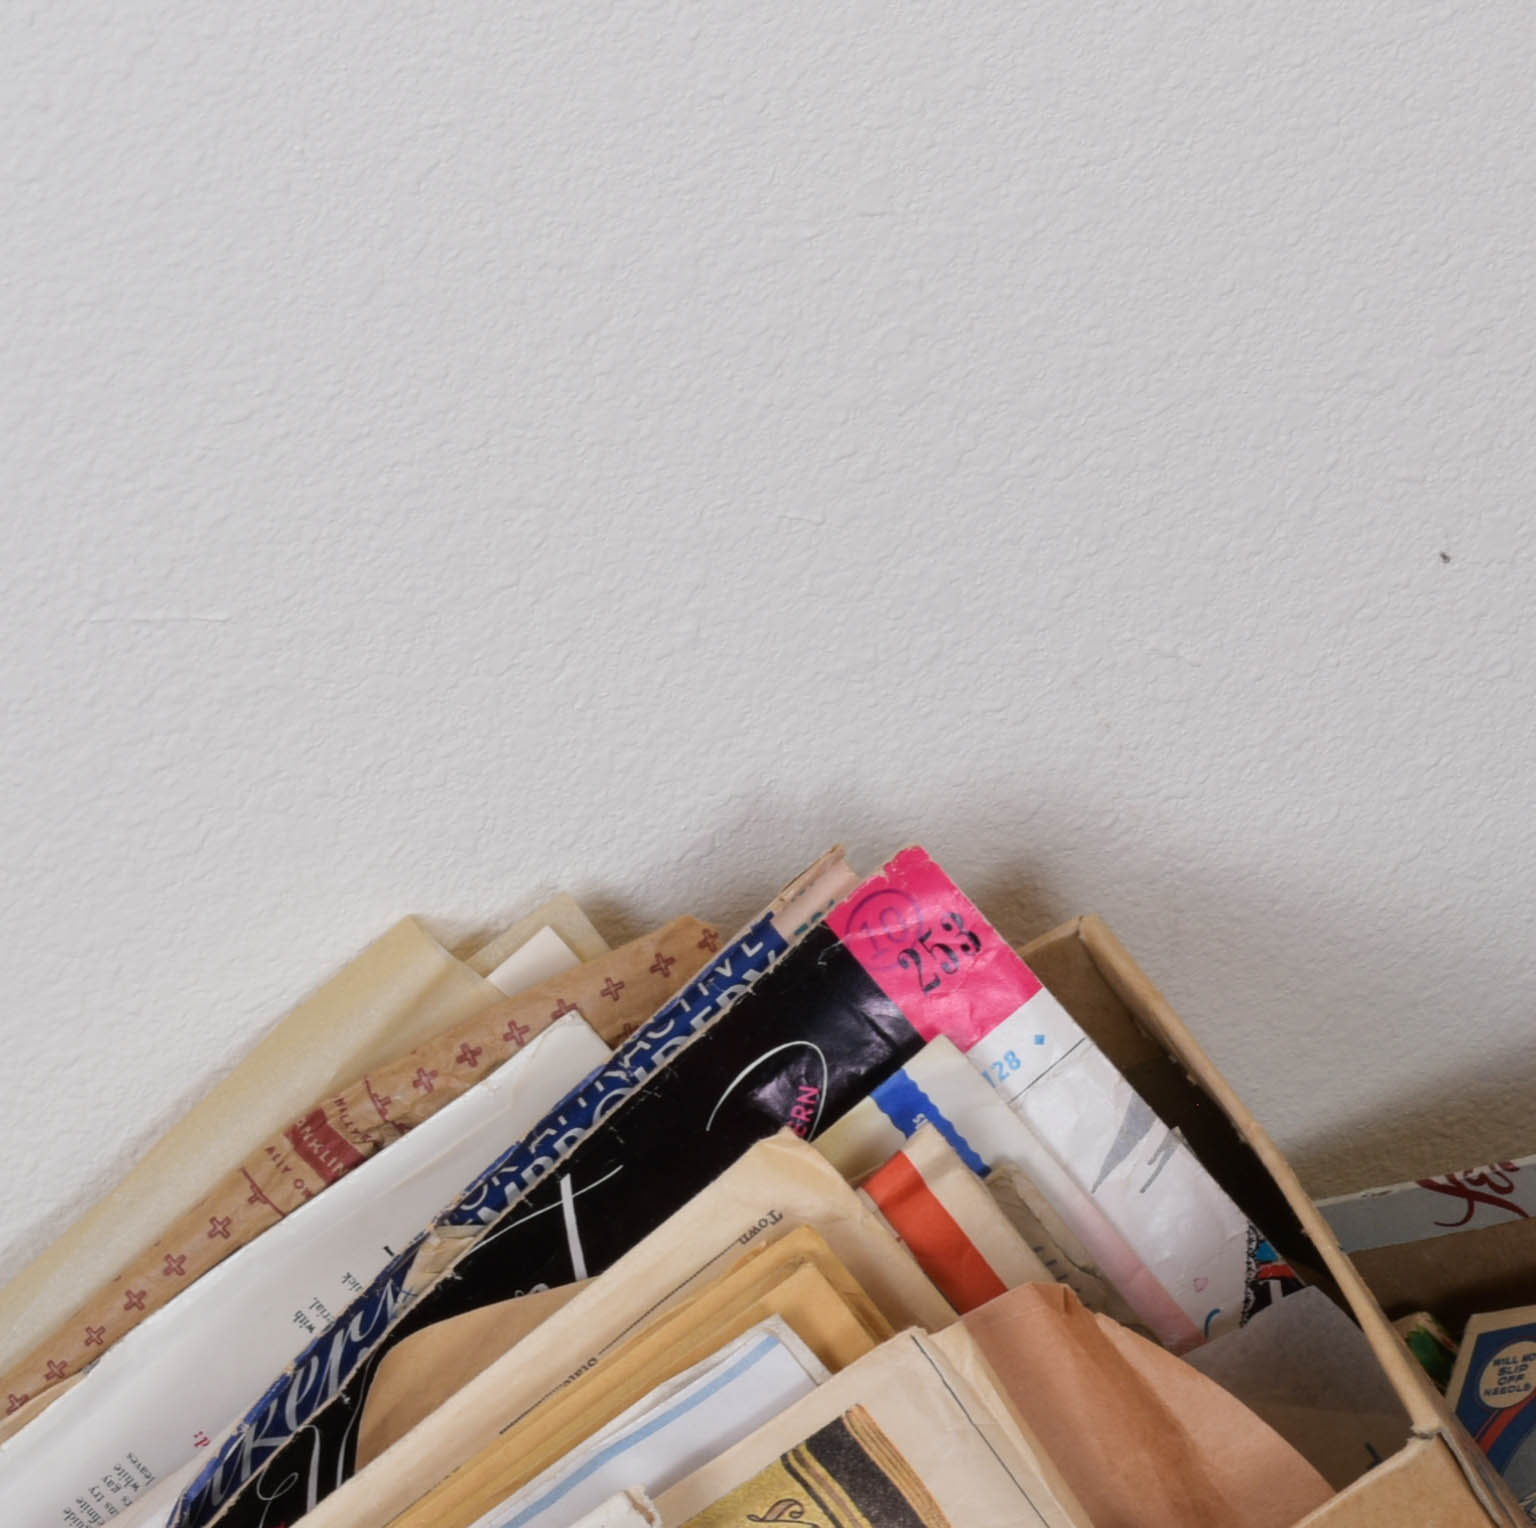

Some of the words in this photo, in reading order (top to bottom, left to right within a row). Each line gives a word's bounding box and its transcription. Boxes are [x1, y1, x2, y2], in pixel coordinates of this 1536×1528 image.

[898, 911, 983, 995] 253
[737, 1208, 784, 1245] Town
[292, 1310, 316, 1334] with
[113, 1464, 140, 1492] white
[127, 1453, 156, 1486] leaves
